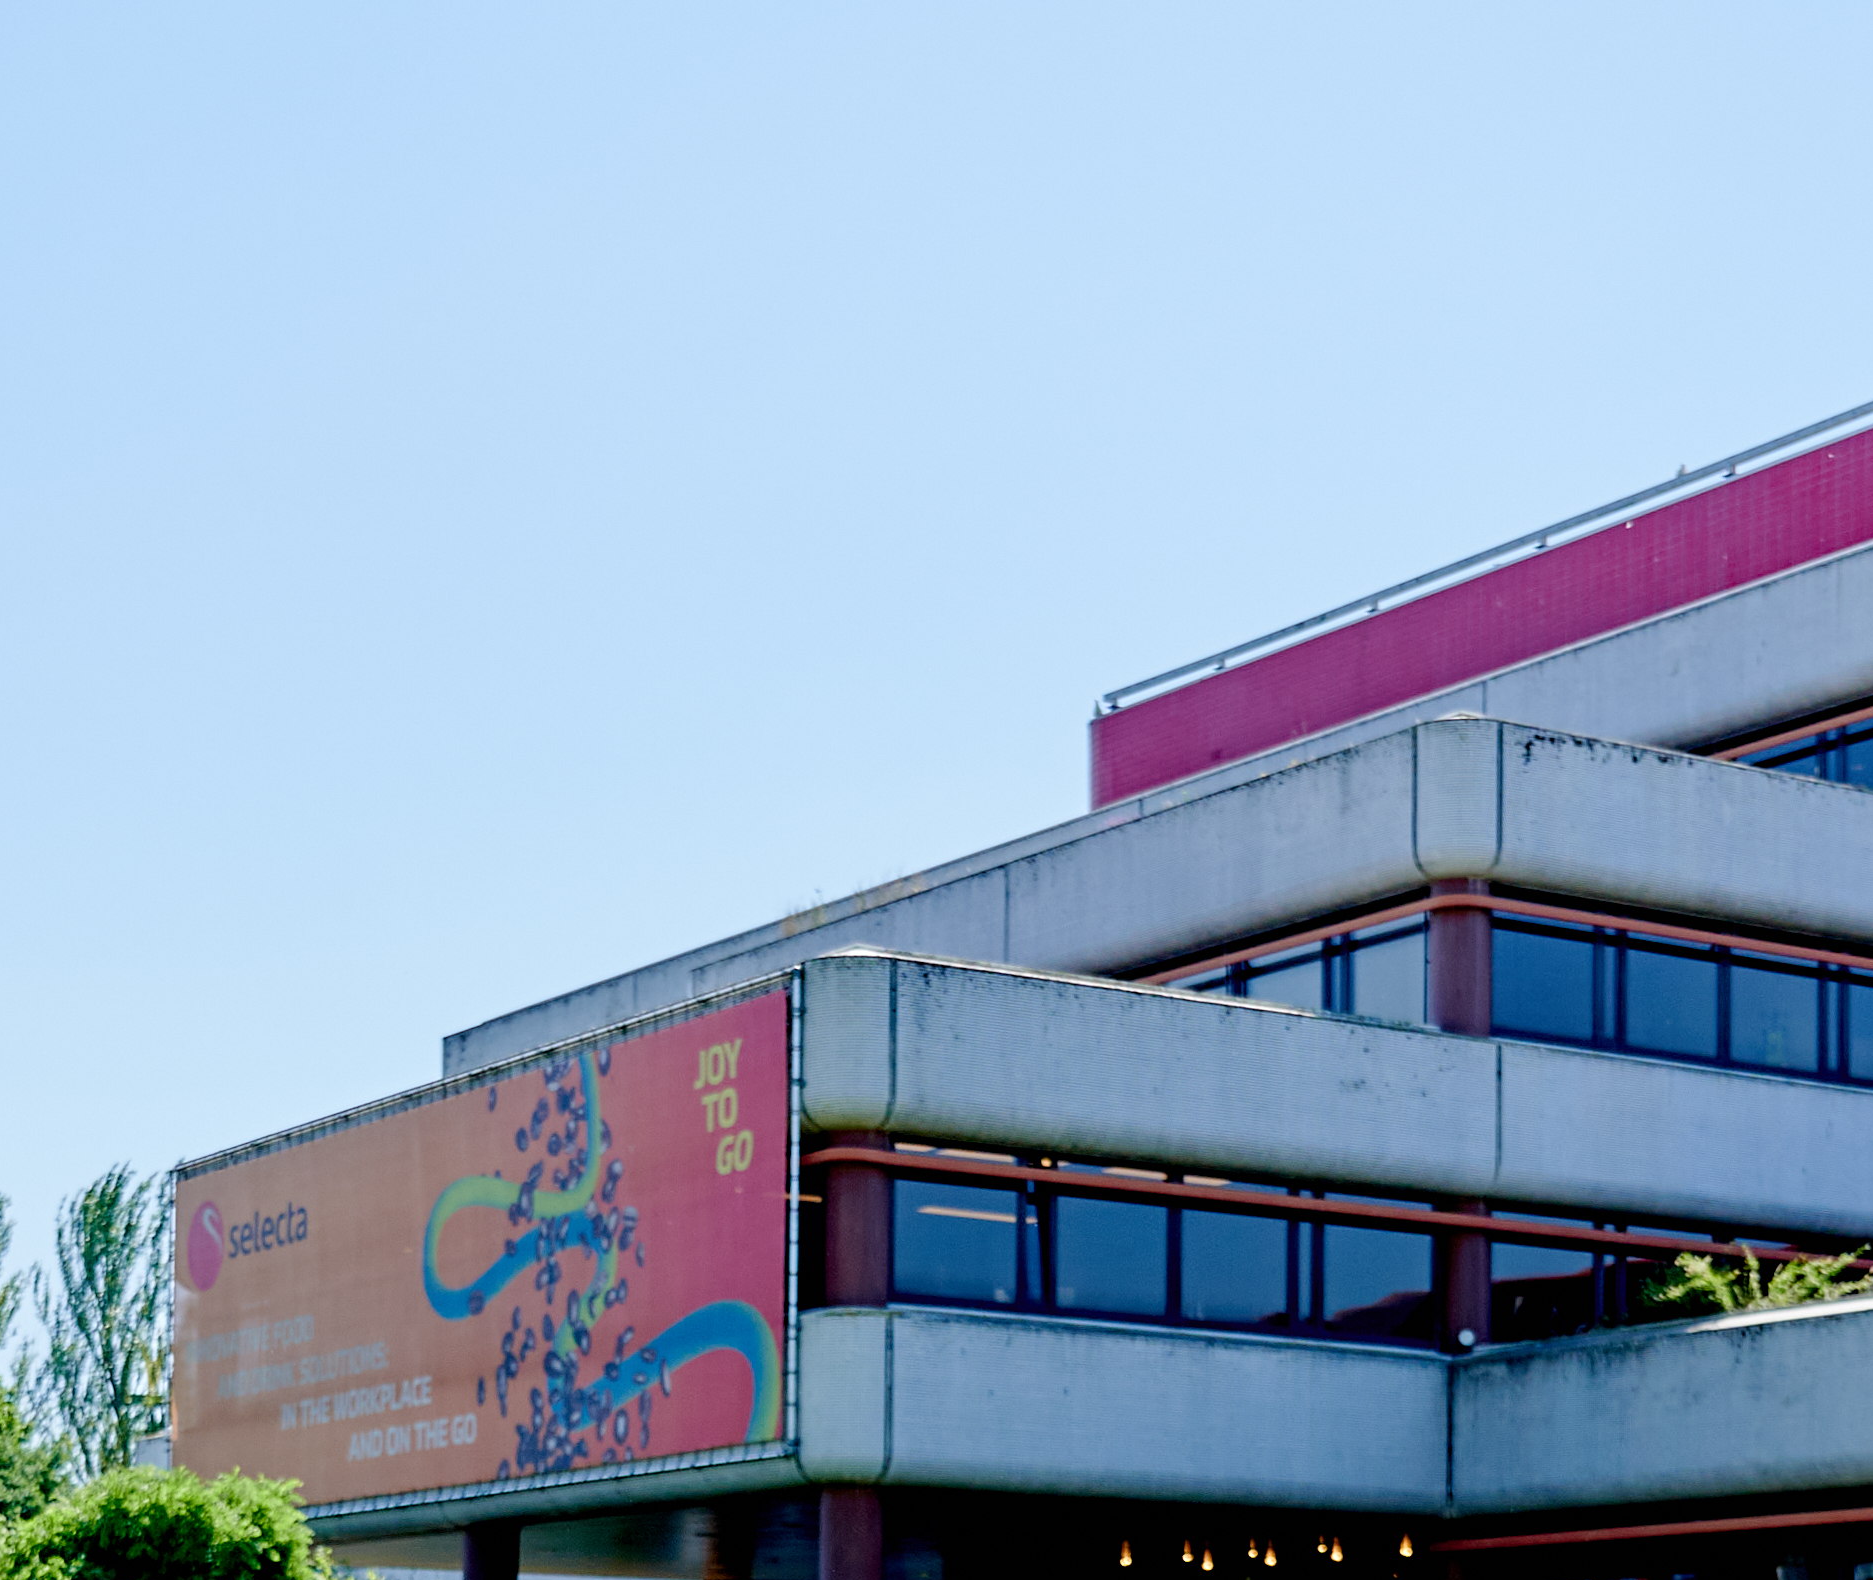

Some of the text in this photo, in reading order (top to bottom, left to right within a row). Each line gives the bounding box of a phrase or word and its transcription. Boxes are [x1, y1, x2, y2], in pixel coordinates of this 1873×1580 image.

[693, 1038, 743, 1090] JOY
[701, 1087, 739, 1133] TO
[715, 1129, 754, 1175] GO
[229, 1202, 309, 1259] selecta
[281, 1375, 432, 1430] IN THE WORKPLACE
[348, 1411, 477, 1461] AND ON THE GO
